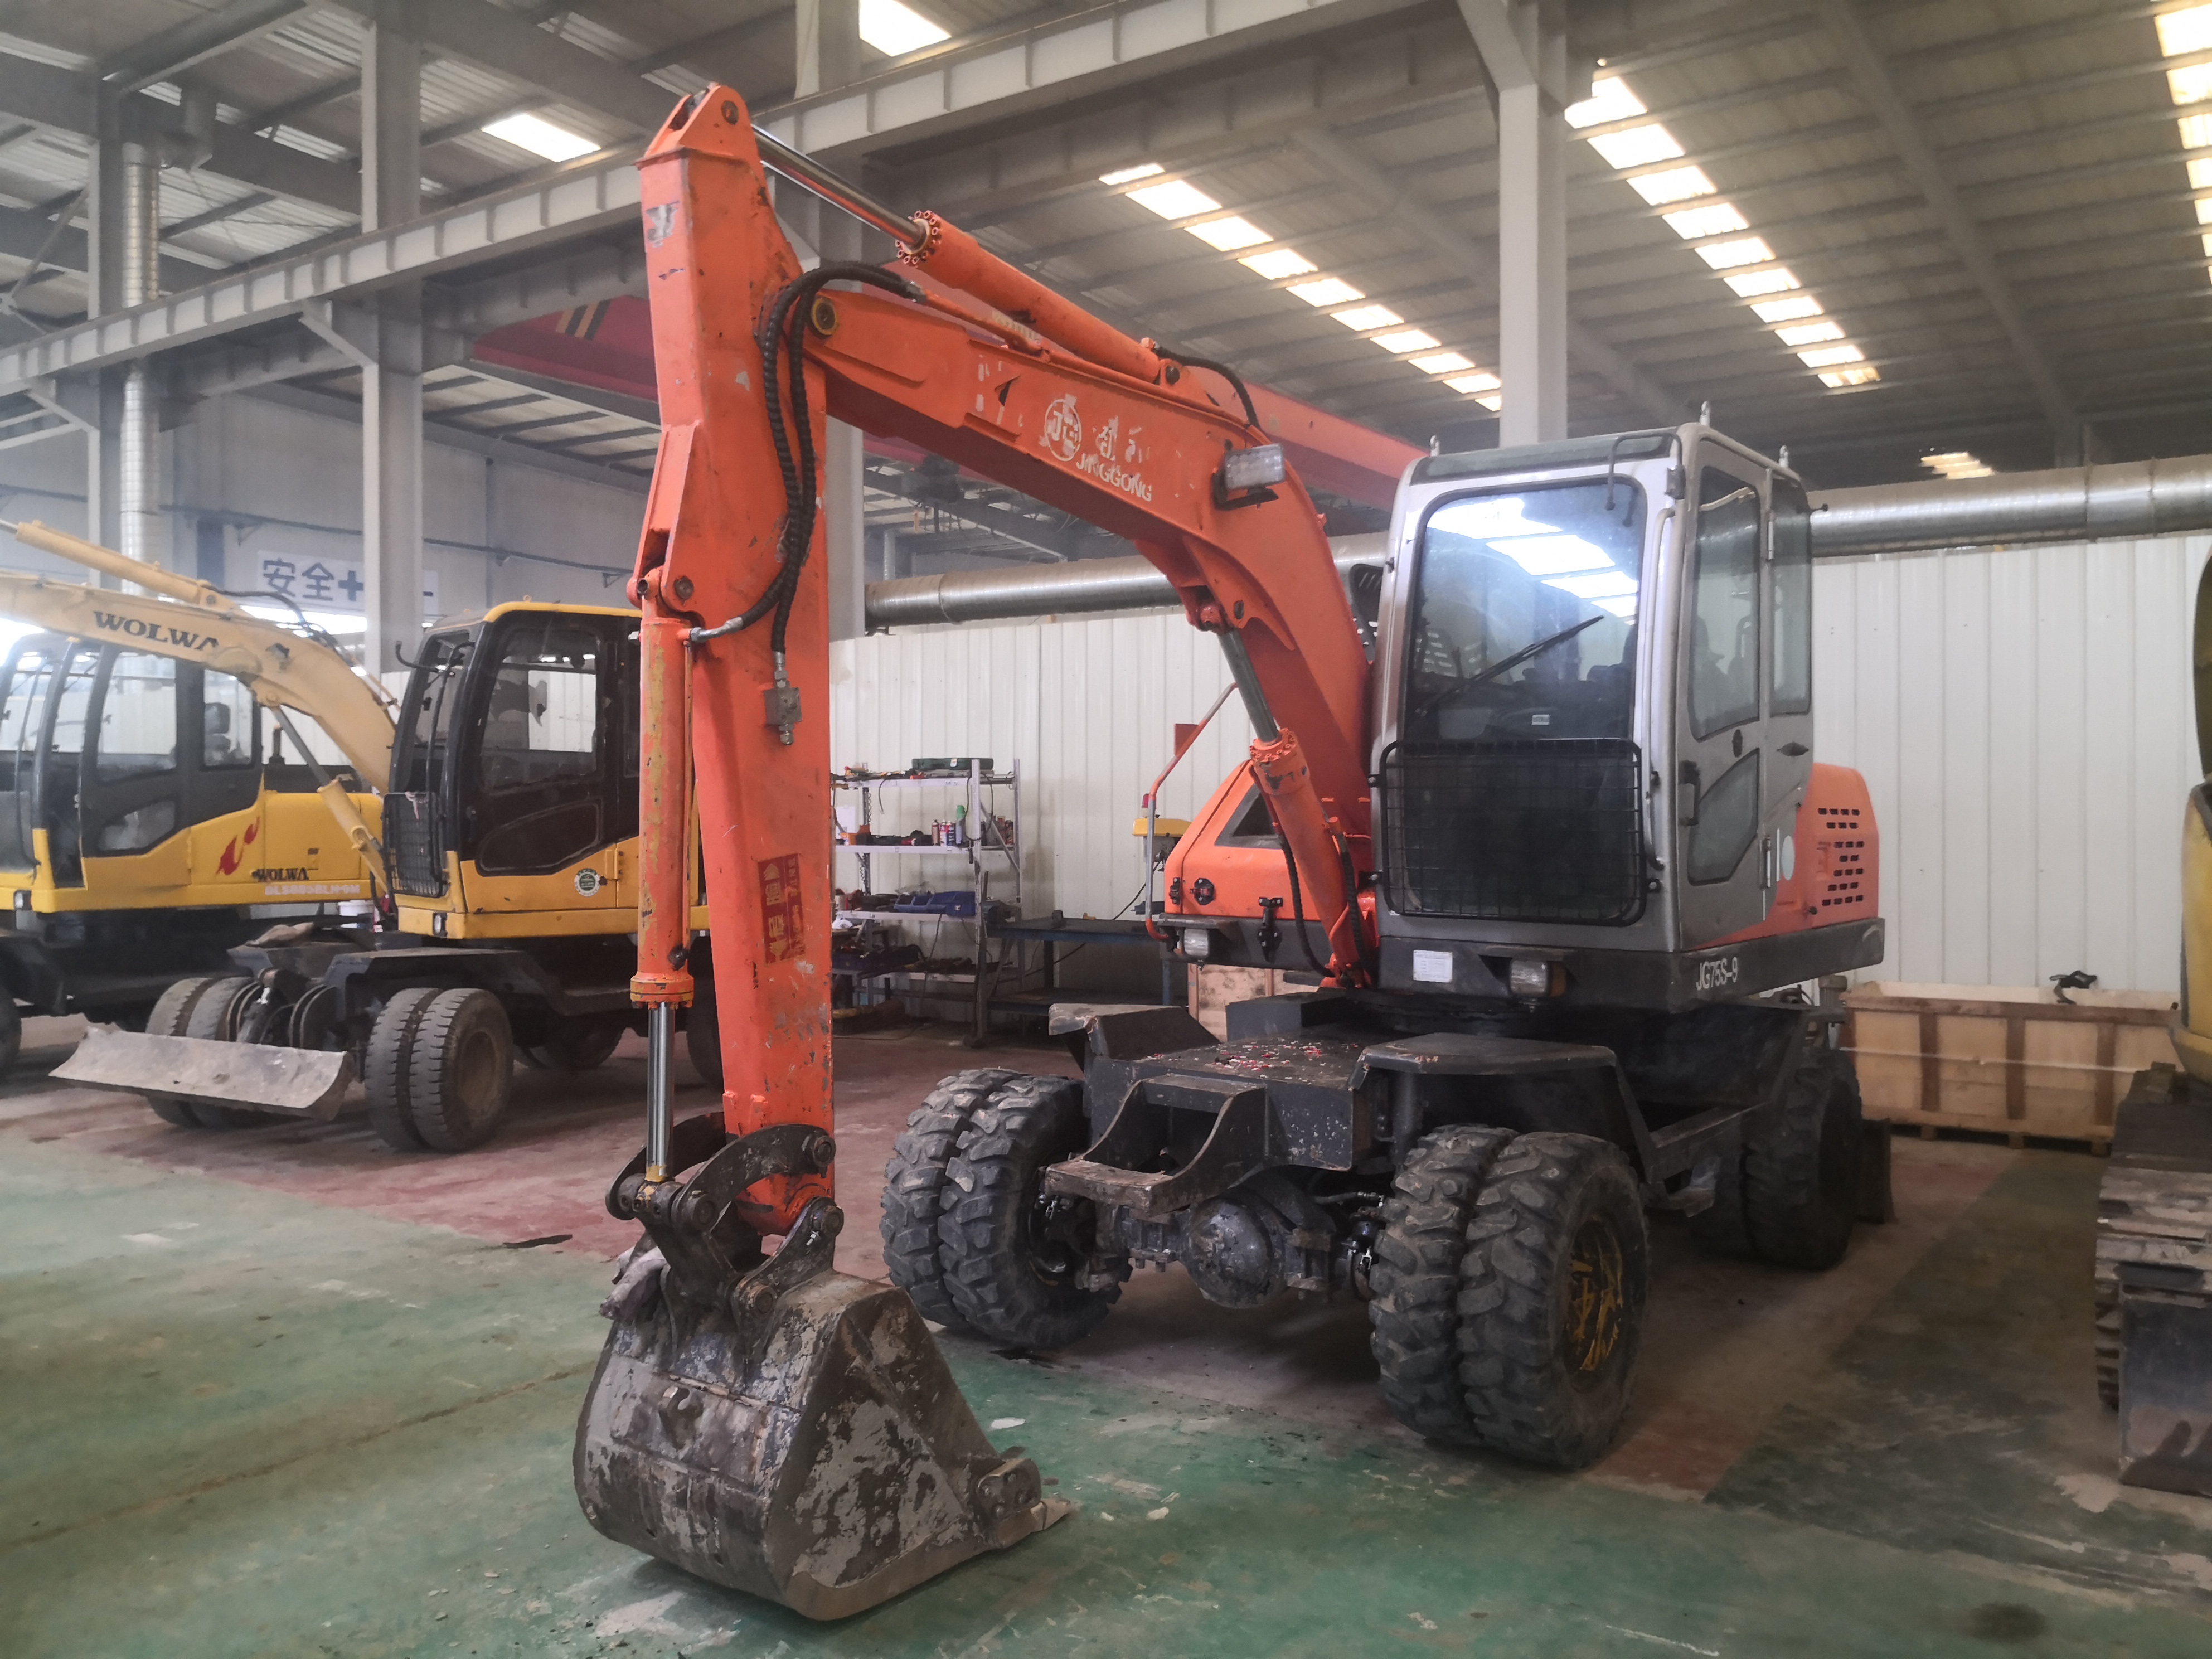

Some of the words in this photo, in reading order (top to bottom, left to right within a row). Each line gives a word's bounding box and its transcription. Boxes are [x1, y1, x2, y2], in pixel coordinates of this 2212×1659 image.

[1076, 453, 1152, 502] JINGGONG
[263, 557, 334, 601] 安全
[1696, 957, 1738, 991] JG75S-9
